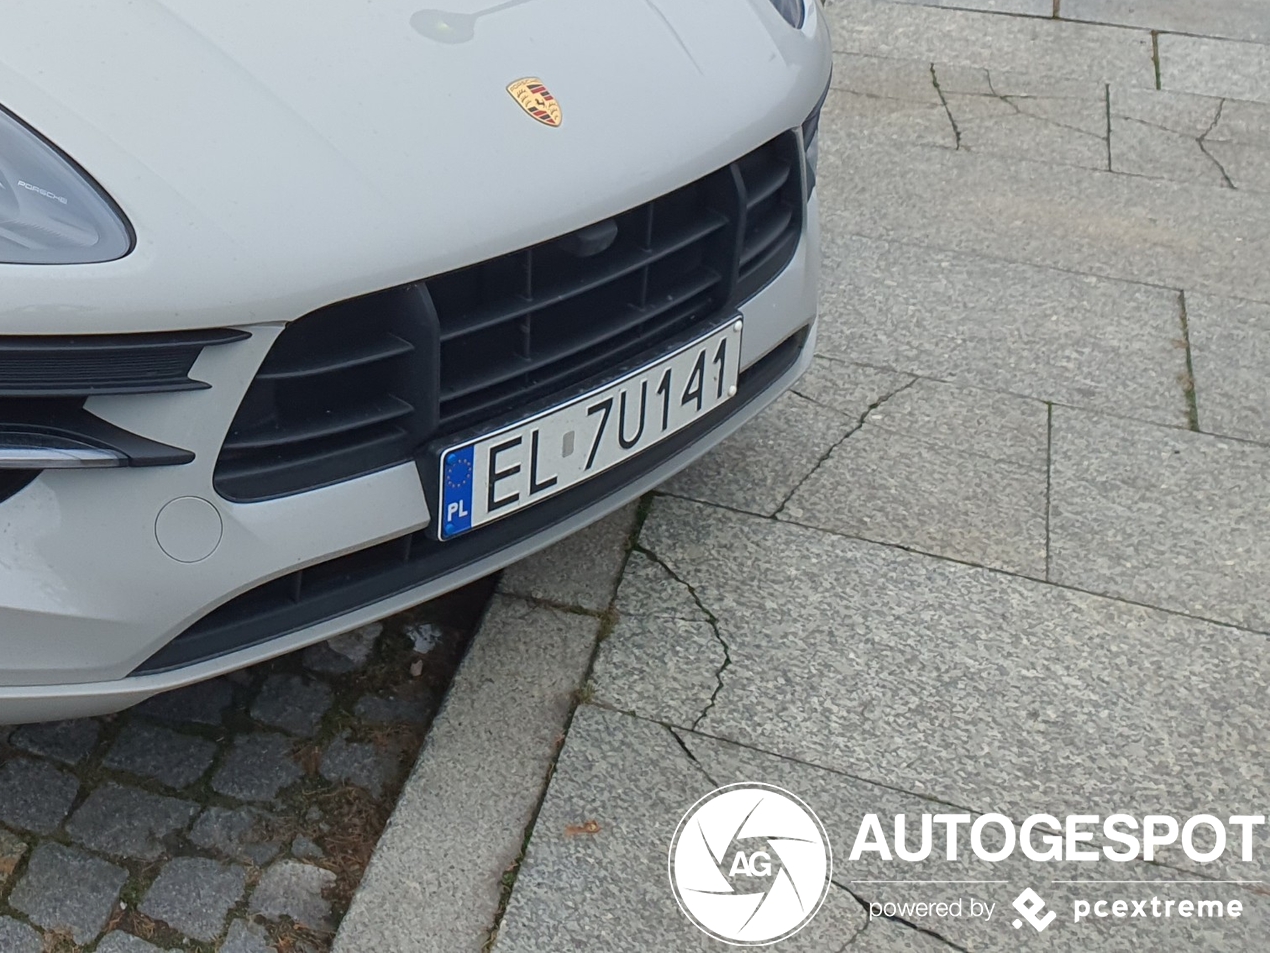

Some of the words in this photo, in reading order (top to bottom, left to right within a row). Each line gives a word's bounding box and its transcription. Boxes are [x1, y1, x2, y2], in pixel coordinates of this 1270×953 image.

[17, 180, 68, 205] PORSCHE
[487, 430, 558, 513] EL
[583, 338, 728, 472] 7U141
[447, 500, 468, 522] PL
